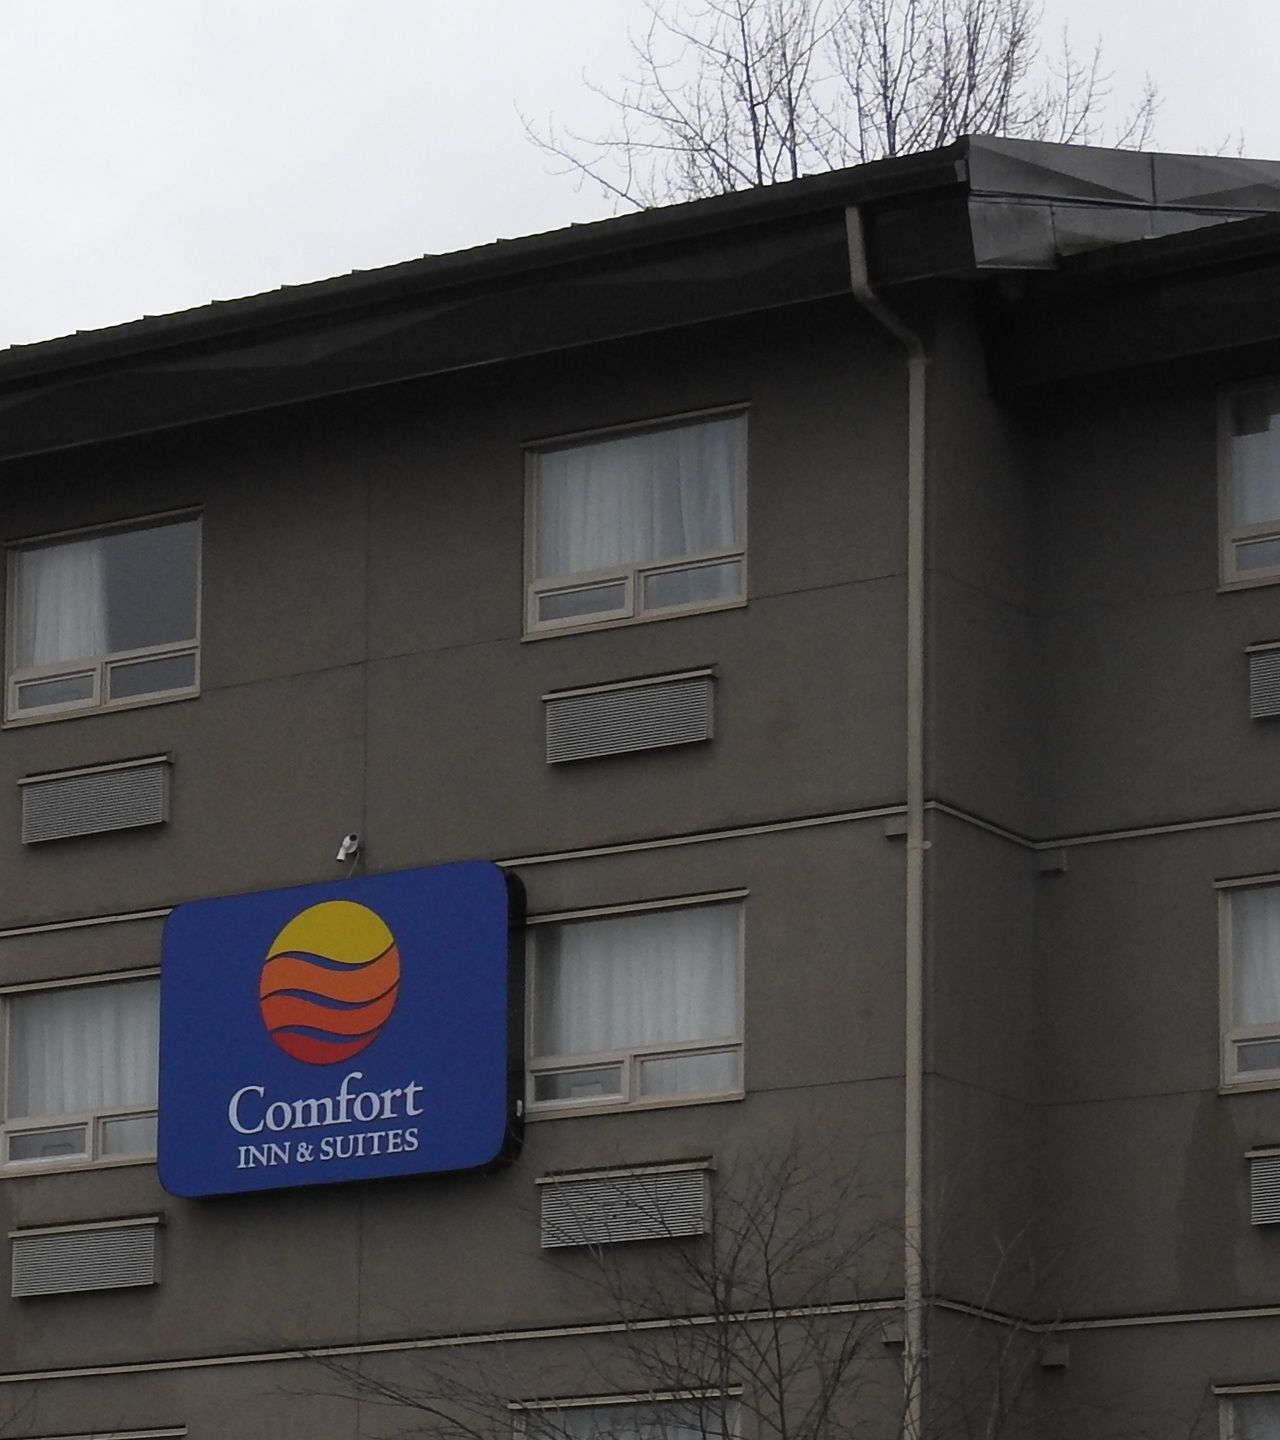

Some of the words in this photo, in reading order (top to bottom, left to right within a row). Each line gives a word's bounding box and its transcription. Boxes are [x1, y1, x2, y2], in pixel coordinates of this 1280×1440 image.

[228, 1072, 425, 1135] Comfort
[236, 1141, 290, 1170] INN
[296, 1140, 315, 1164] &
[319, 1128, 420, 1162] SUITES
